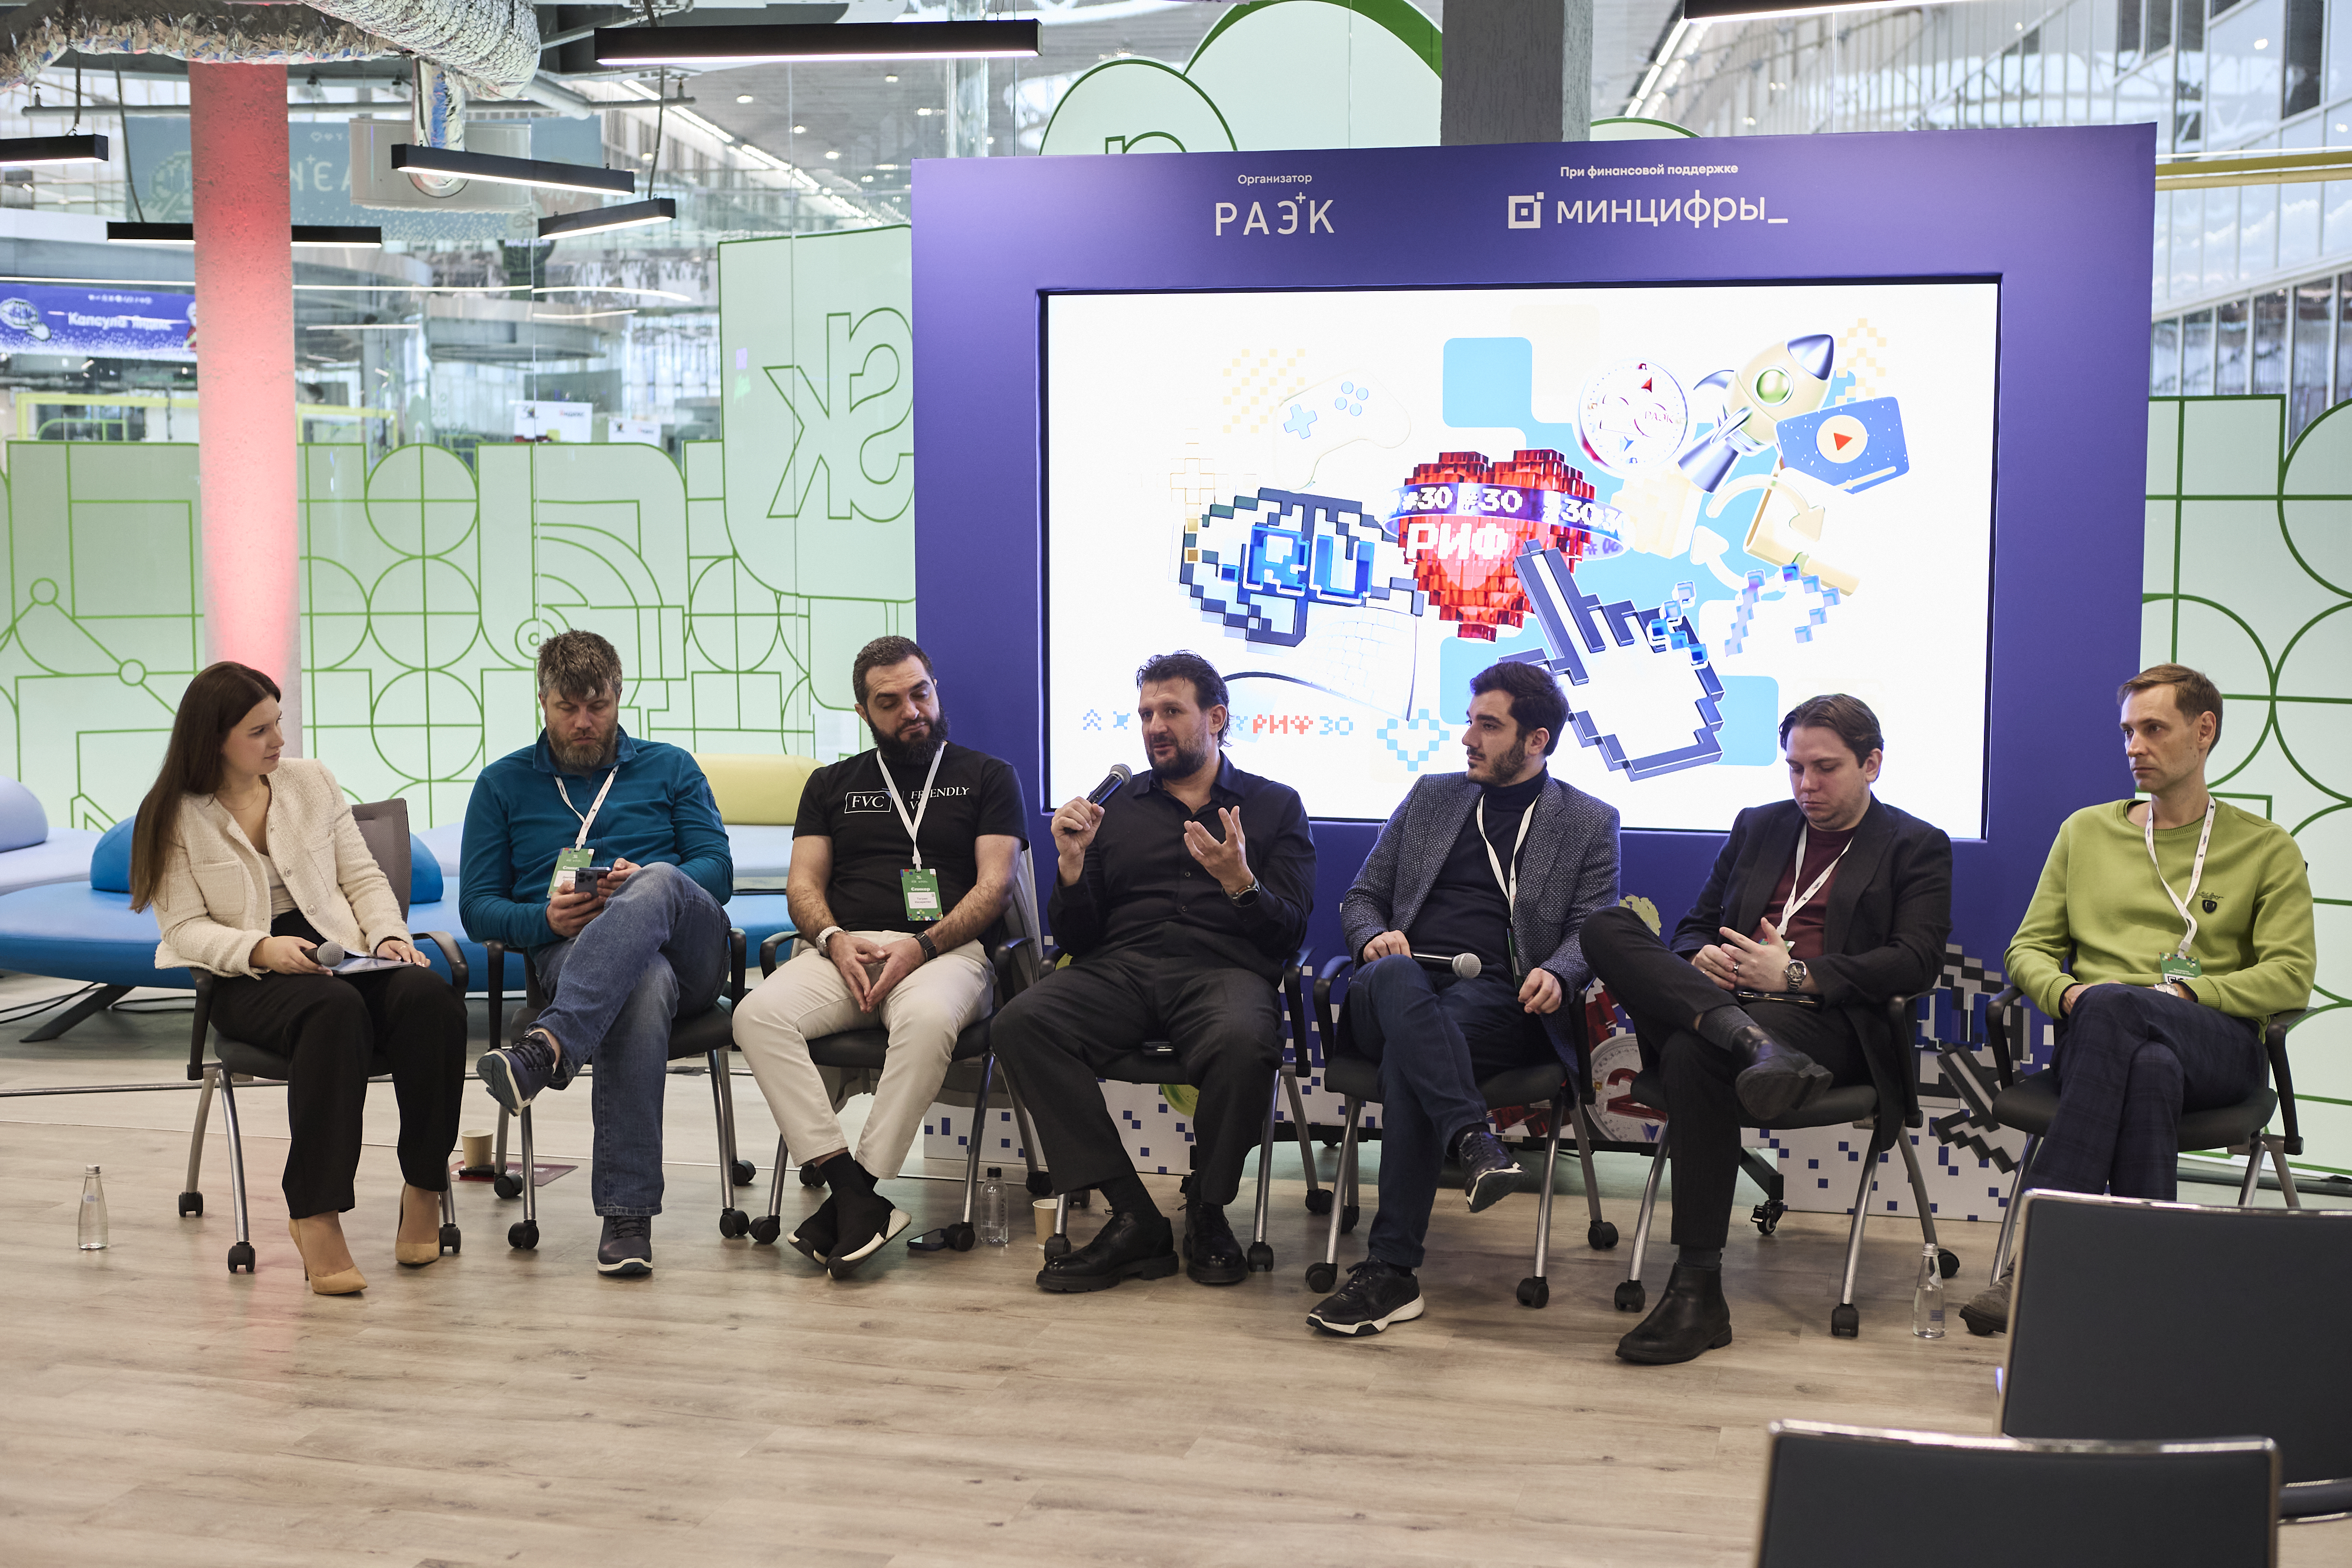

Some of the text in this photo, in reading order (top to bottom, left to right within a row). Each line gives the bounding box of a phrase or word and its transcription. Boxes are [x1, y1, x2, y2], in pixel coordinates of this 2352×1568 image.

[1560, 164, 1739, 179] При финансовой поддержке
[1238, 175, 1312, 186] Организатор
[1215, 199, 1335, 236] РАЭК
[1406, 523, 1509, 560] РИФ
[1319, 716, 1354, 735] 30
[911, 787, 970, 800] FRENDLY
[852, 795, 884, 808] FVC
